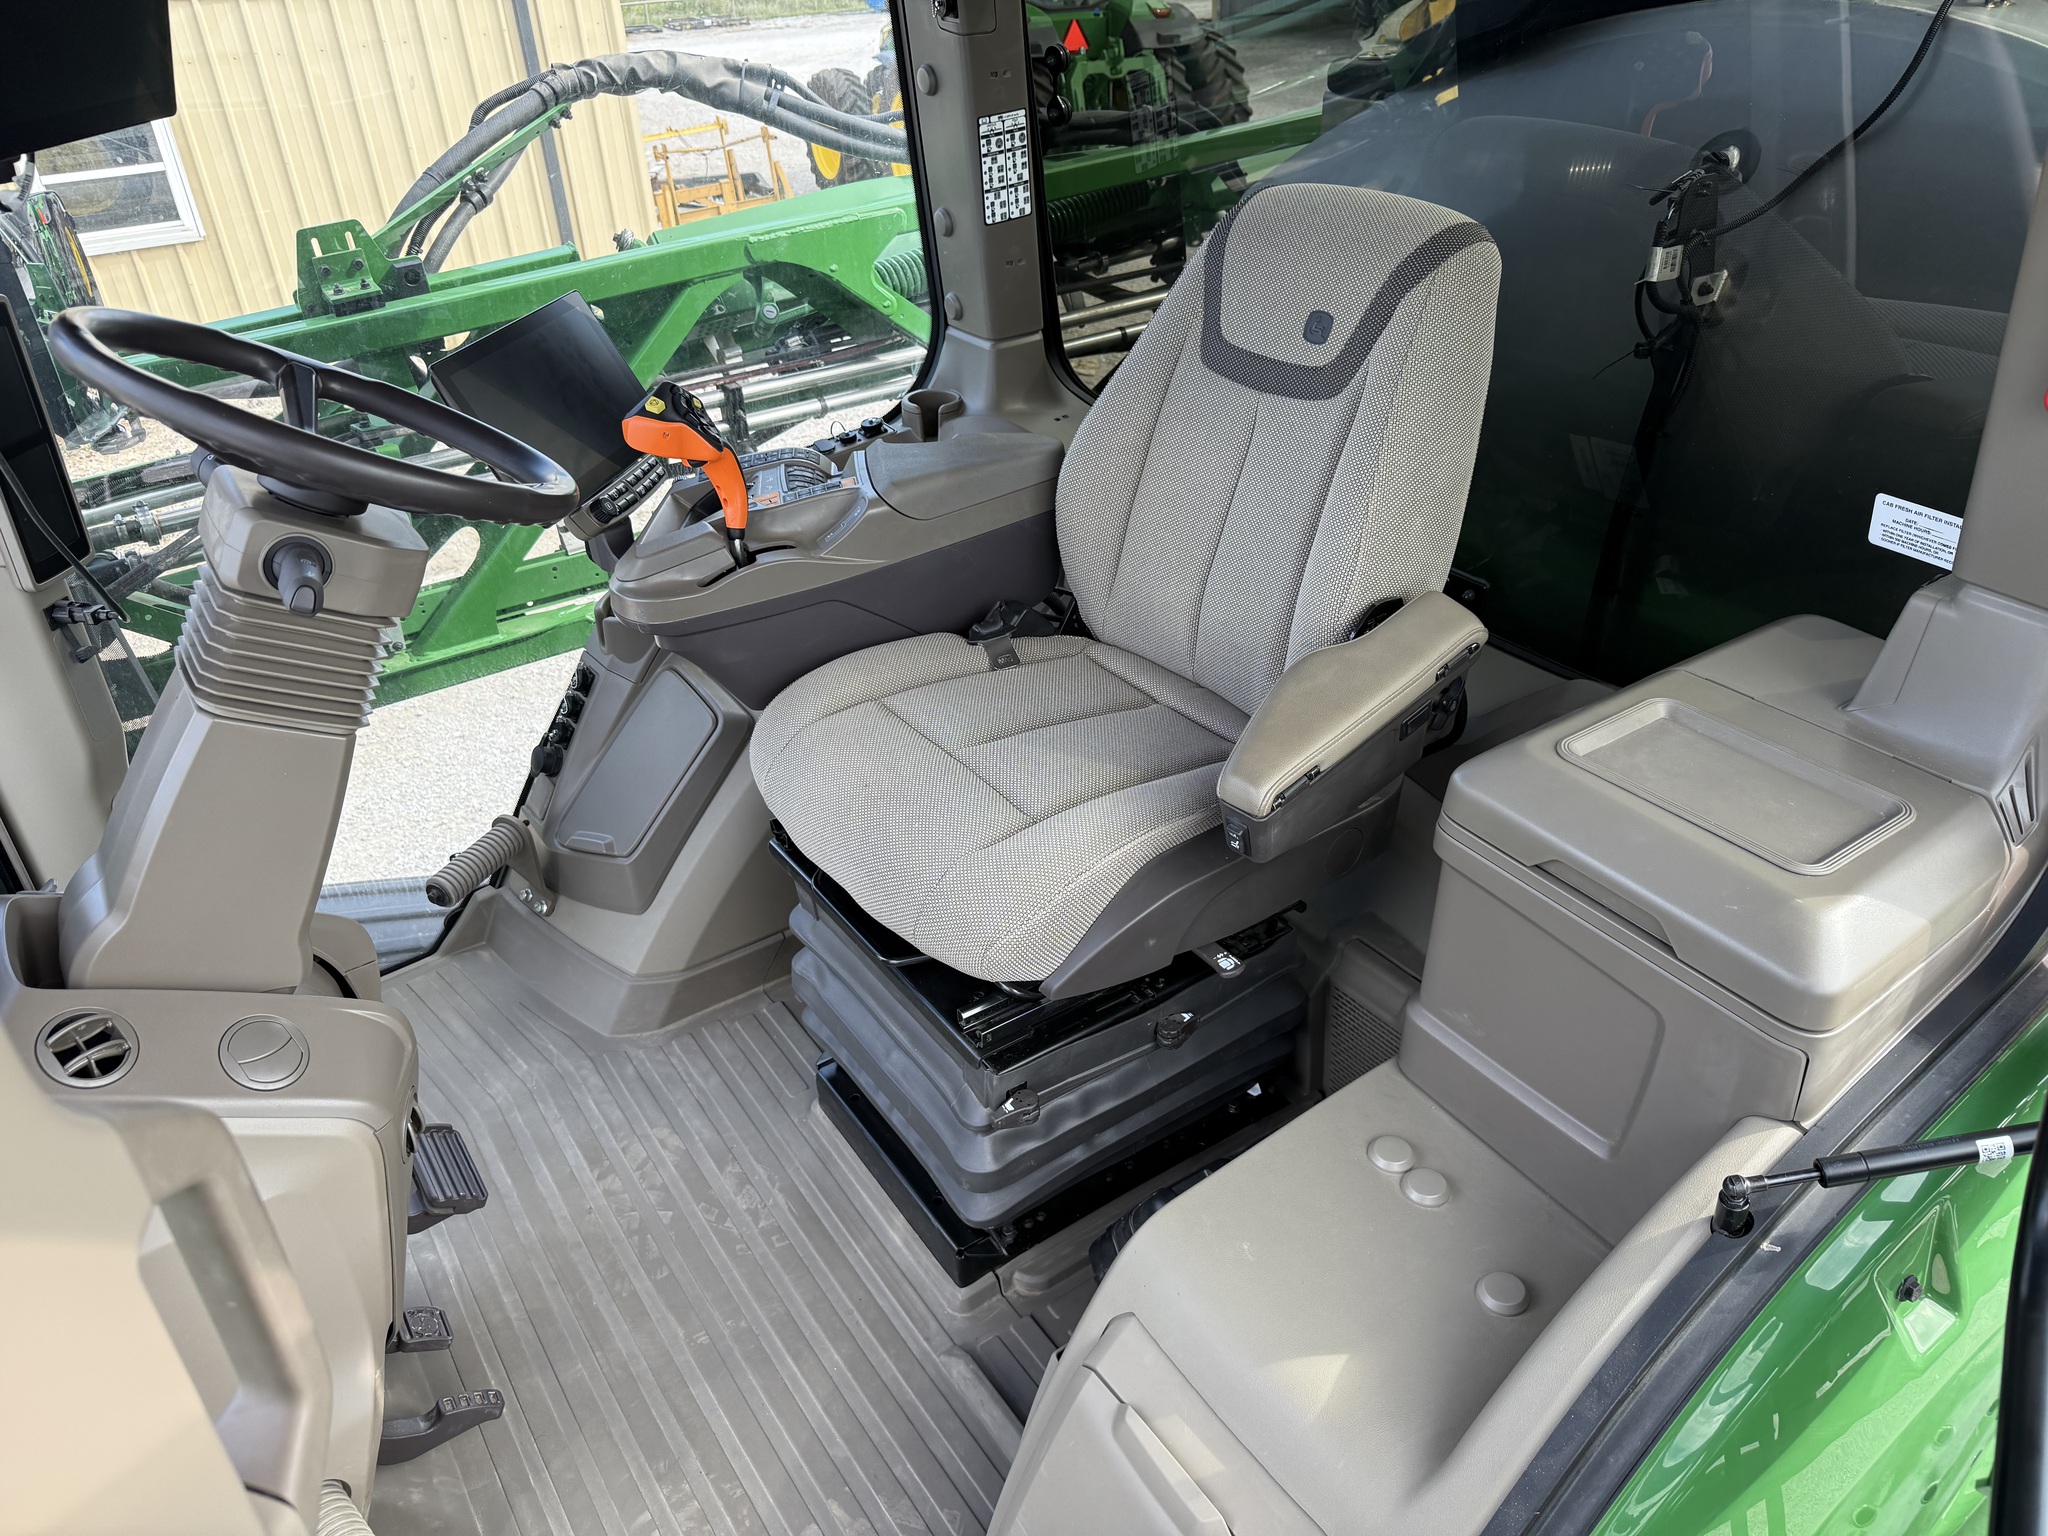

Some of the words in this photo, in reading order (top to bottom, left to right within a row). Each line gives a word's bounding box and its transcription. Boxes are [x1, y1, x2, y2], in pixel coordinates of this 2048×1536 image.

[1894, 504, 1913, 514] FRESH
[1924, 514, 1943, 523] FILTER
[1880, 523, 1898, 532] REPLACE
[1938, 542, 1952, 550] COMES
[1892, 519, 1913, 529] MACHINE
[1914, 526, 1932, 536] HOURS:
